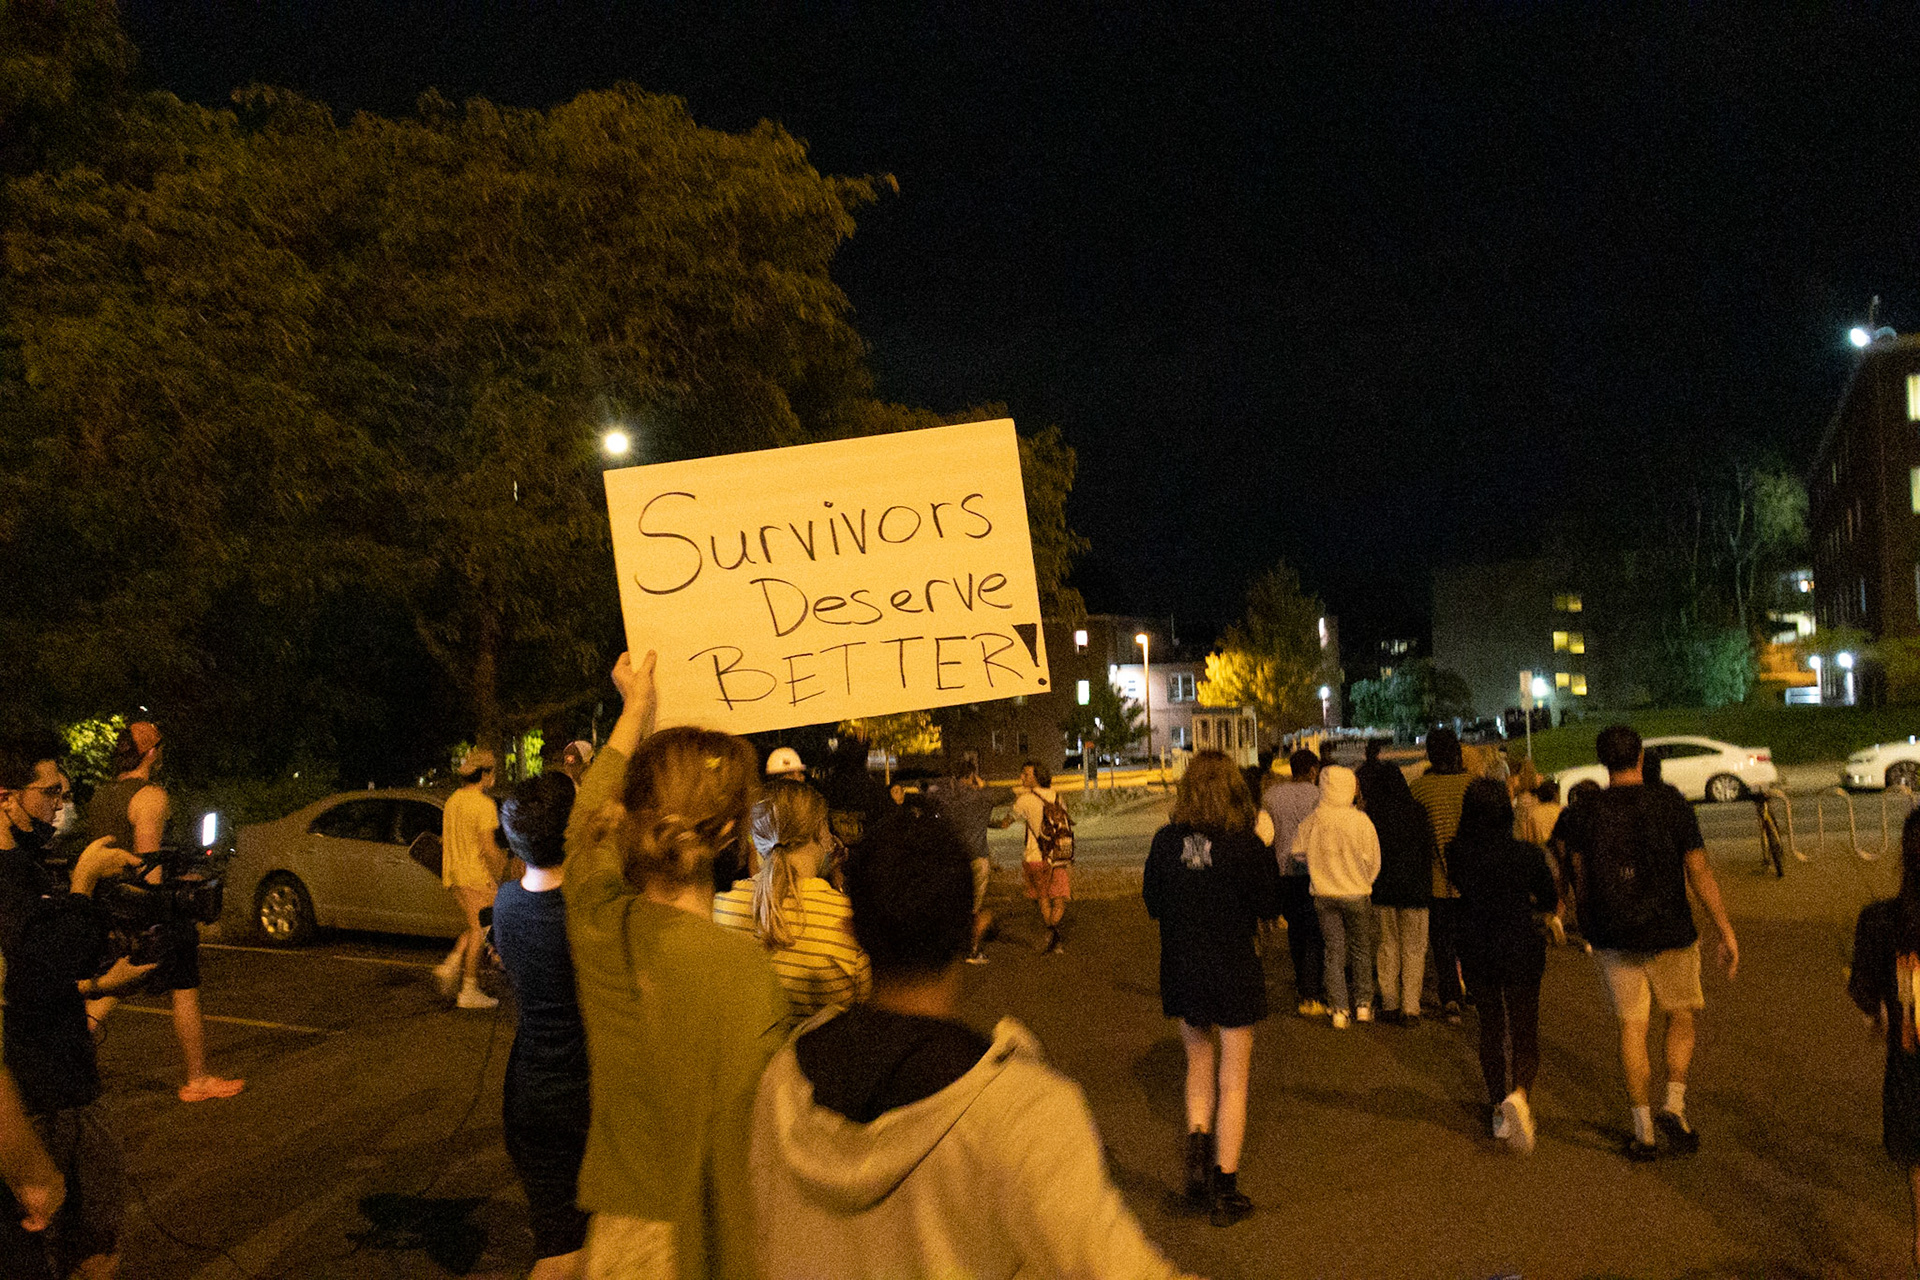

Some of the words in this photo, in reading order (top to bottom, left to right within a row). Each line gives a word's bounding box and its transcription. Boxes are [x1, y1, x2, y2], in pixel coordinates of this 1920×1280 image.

[634, 491, 993, 595] Survivors
[749, 572, 1014, 638] Deserve
[688, 622, 1048, 711] BETTER!
